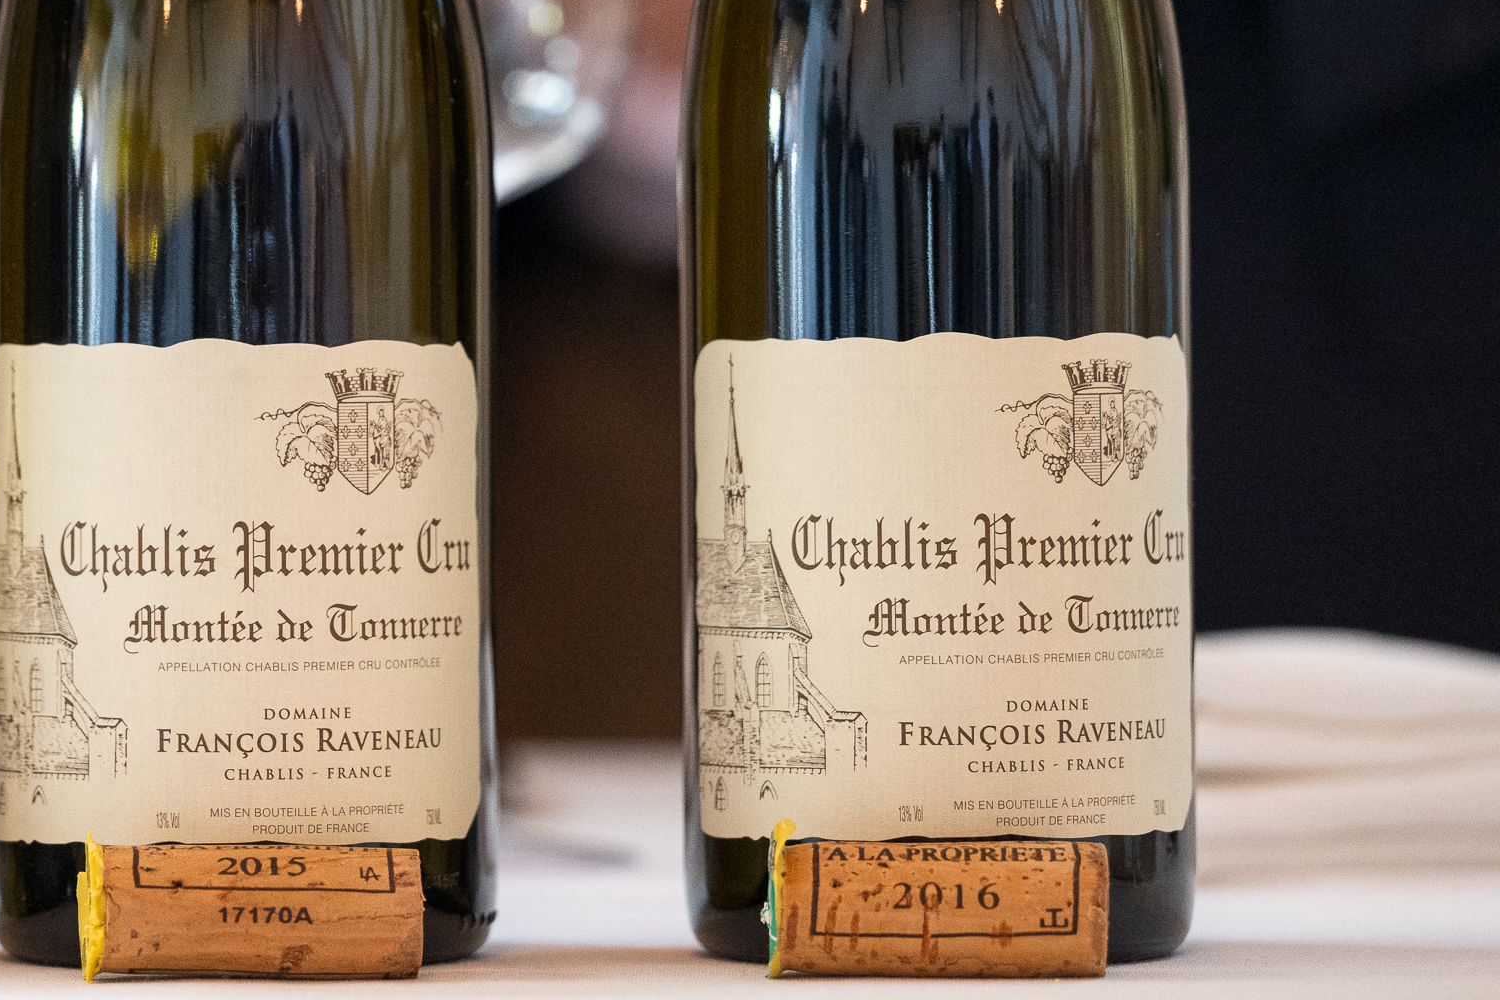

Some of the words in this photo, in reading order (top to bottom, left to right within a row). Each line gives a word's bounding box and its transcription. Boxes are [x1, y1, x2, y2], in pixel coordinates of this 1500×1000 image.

[60, 521, 215, 592] Chablis
[233, 521, 404, 593] Premier
[417, 518, 470, 573] Cru
[791, 514, 958, 586] Chablis
[974, 513, 1133, 585] Premier
[1144, 509, 1185, 565] Cru
[124, 604, 263, 654] Montée
[276, 609, 313, 643] de
[326, 604, 462, 643] Tonnerre
[863, 597, 1004, 647] Montée
[1017, 601, 1053, 634] de
[1065, 595, 1180, 634] Tonnerre
[158, 662, 241, 672] APPELLATION
[245, 661, 299, 672] CHABLIS
[303, 660, 355, 671] PREMIER
[358, 659, 381, 670] CRU
[385, 656, 441, 669] CONTRÔLÉE
[899, 654, 984, 665] APPELLATION
[988, 654, 1040, 664] CHABLIS
[1044, 652, 1091, 663] PREMIER
[1095, 652, 1115, 662] CRU
[264, 707, 352, 720] DOMAINE
[1006, 698, 1089, 713] DOMAINE
[157, 728, 304, 758] FRANÇOIS
[317, 727, 442, 753] RAVENEAU
[899, 721, 1045, 751] FRANÇOIS
[1057, 718, 1166, 744] RAVENEAU
[224, 768, 304, 781] CHABLIS
[327, 765, 391, 779] FRANCE
[968, 759, 1046, 773] CHABLIS
[1067, 756, 1125, 771] FRANCE
[210, 808, 231, 818] MIS
[234, 808, 250, 818] EN
[254, 807, 317, 817] BOUTEILLE
[321, 804, 328, 816] À
[331, 806, 346, 816] LA
[349, 803, 404, 815] PROPRIÉTÉ
[954, 801, 975, 810] MIS
[979, 800, 994, 810] EN
[998, 799, 1058, 809] BOUTEILLE
[1062, 797, 1069, 808] À
[1071, 799, 1084, 808] LA
[1087, 795, 1136, 807] PROPRIÉTÉ
[156, 812, 169, 829] 13%
[170, 812, 180, 829] Vol
[899, 806, 912, 822] 13%
[914, 805, 923, 822] Vol
[996, 816, 1047, 827] PRODUIT
[1049, 816, 1065, 826] DE
[1067, 814, 1106, 825] FRANCE
[252, 824, 304, 835] PRODUIT
[308, 824, 324, 834] DE
[327, 823, 369, 833] FRANCE
[827, 847, 848, 861] A
[858, 847, 896, 861] LA
[907, 847, 1067, 861] PROPRIETE
[217, 856, 307, 876] 2015
[892, 882, 1001, 909] 2016
[218, 907, 312, 924] 17170A
